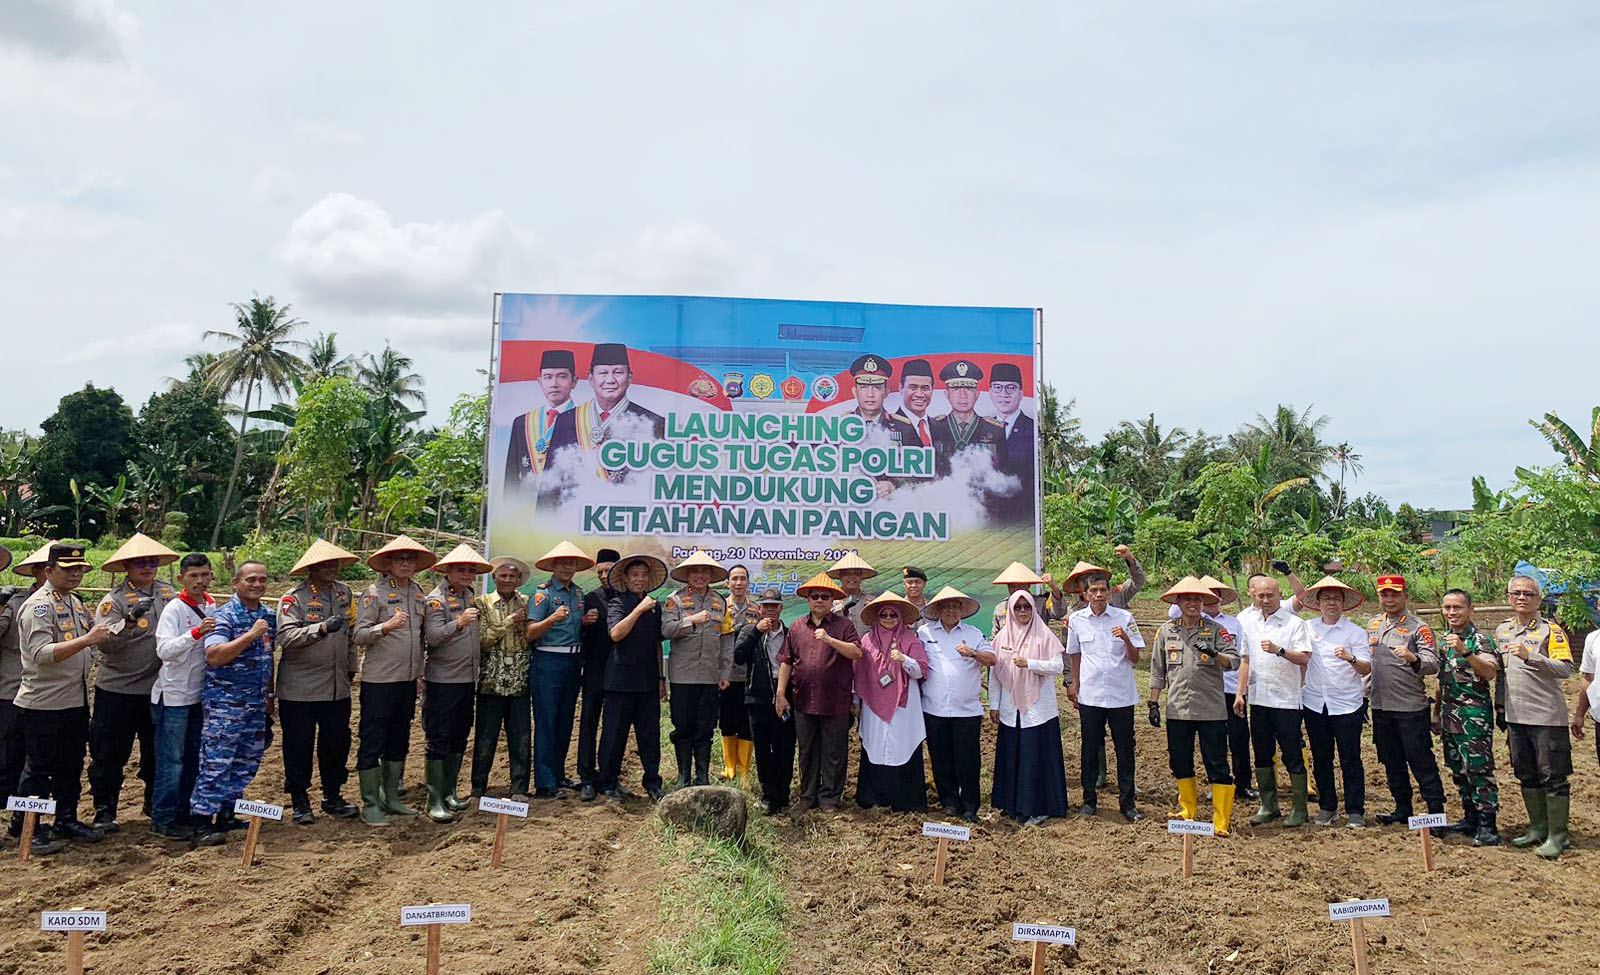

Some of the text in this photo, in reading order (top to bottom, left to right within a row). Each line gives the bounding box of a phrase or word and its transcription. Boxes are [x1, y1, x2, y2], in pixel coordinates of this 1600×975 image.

[667, 411, 865, 442] LAUNCHING
[600, 441, 934, 475] GUGUS TUGAS POLRI
[653, 474, 875, 504] MENDUKUNG
[582, 505, 947, 538] KETAHANAN PANGAN
[672, 545, 726, 561] Padng,
[749, 547, 820, 561] November
[14, 800, 49, 811] KA SPKT
[238, 802, 279, 817] KABIDKEU
[483, 801, 525, 813] KOORSPRIPIM
[1411, 816, 1443, 827] DIRTAHTI
[925, 826, 967, 837] DIRPAMOBVIT
[405, 910, 466, 920] DANSATBRIMOB
[1332, 903, 1386, 915] KABIDPROPAM
[48, 916, 100, 926] KARO SDM
[1017, 927, 1071, 939] DIRSAMAPTA
